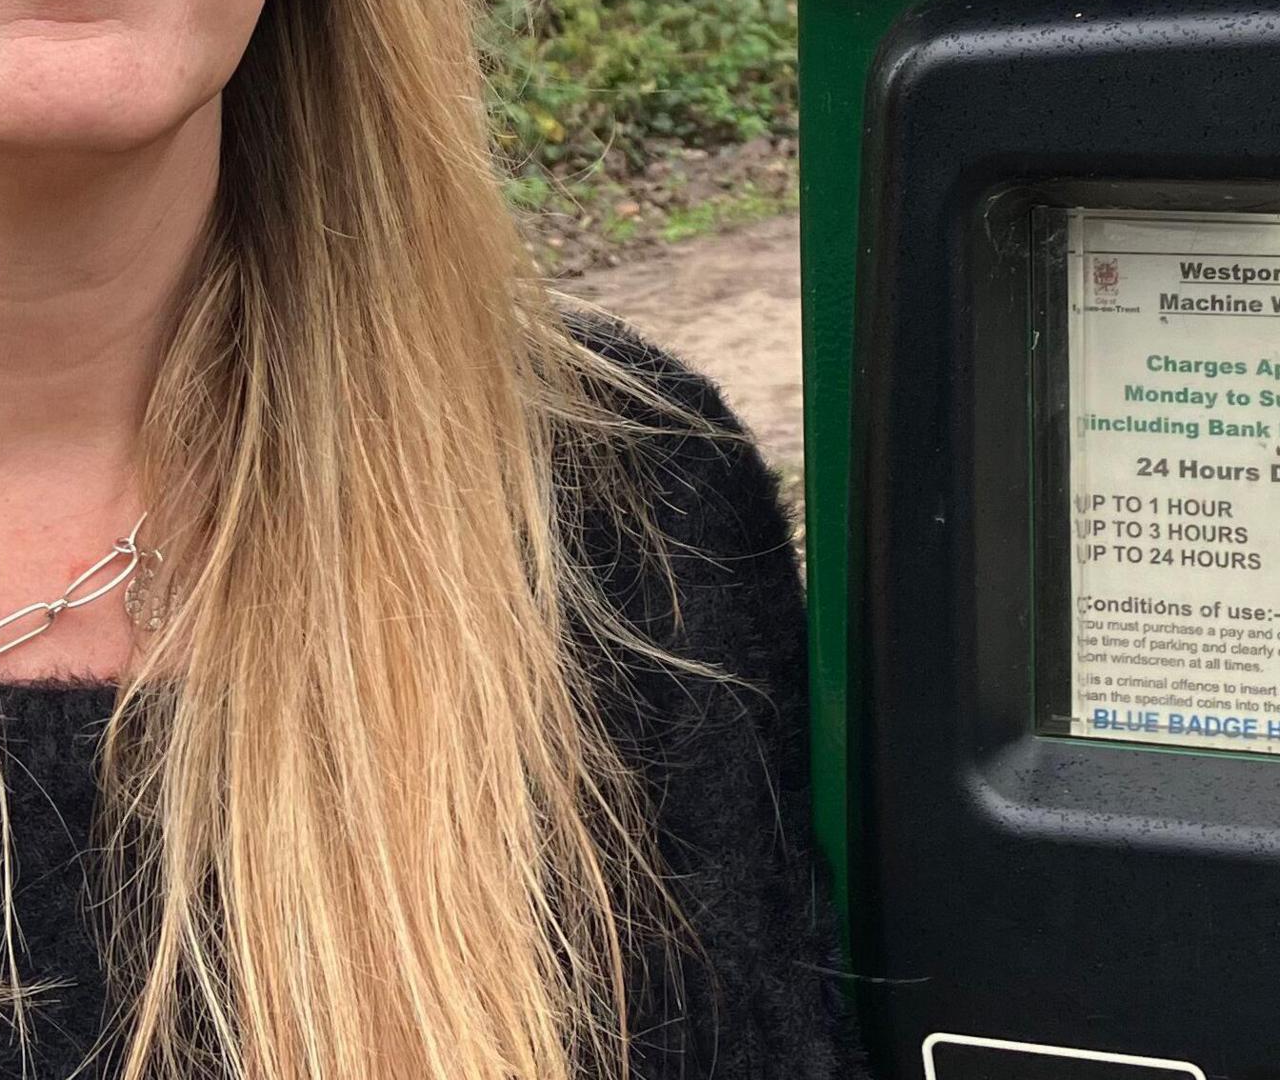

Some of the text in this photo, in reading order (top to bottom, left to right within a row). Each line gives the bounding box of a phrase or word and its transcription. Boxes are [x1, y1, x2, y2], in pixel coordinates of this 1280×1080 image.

[1160, 293, 1262, 313] Machine
[1147, 355, 1248, 377] Charges
[1124, 385, 1218, 409] Monday
[1227, 389, 1250, 406] to
[1209, 420, 1270, 439] Bank
[1136, 458, 1170, 478] 24
[1179, 460, 1260, 482] Hours
[1112, 496, 1143, 514] TO
[1149, 498, 1159, 516] 1
[1167, 498, 1233, 519] HOUR
[1112, 521, 1143, 540] TO
[1149, 523, 1161, 541] 3
[1168, 524, 1249, 544] HOURS
[1113, 546, 1143, 565] TO
[1149, 548, 1174, 567] 24
[1181, 549, 1262, 571] HOURS
[1200, 600, 1221, 618] of
[1107, 622, 1139, 631] must
[1142, 623, 1204, 635] purchase
[1207, 627, 1216, 636] a
[1219, 628, 1245, 640] pay
[1247, 628, 1274, 640] and
[1110, 691, 1132, 703] the
[1134, 694, 1193, 707] specified
[1196, 698, 1232, 709] coins
[1235, 699, 1260, 711] into
[1093, 708, 1159, 733] BLUE
[1168, 712, 1257, 739] BADGE
